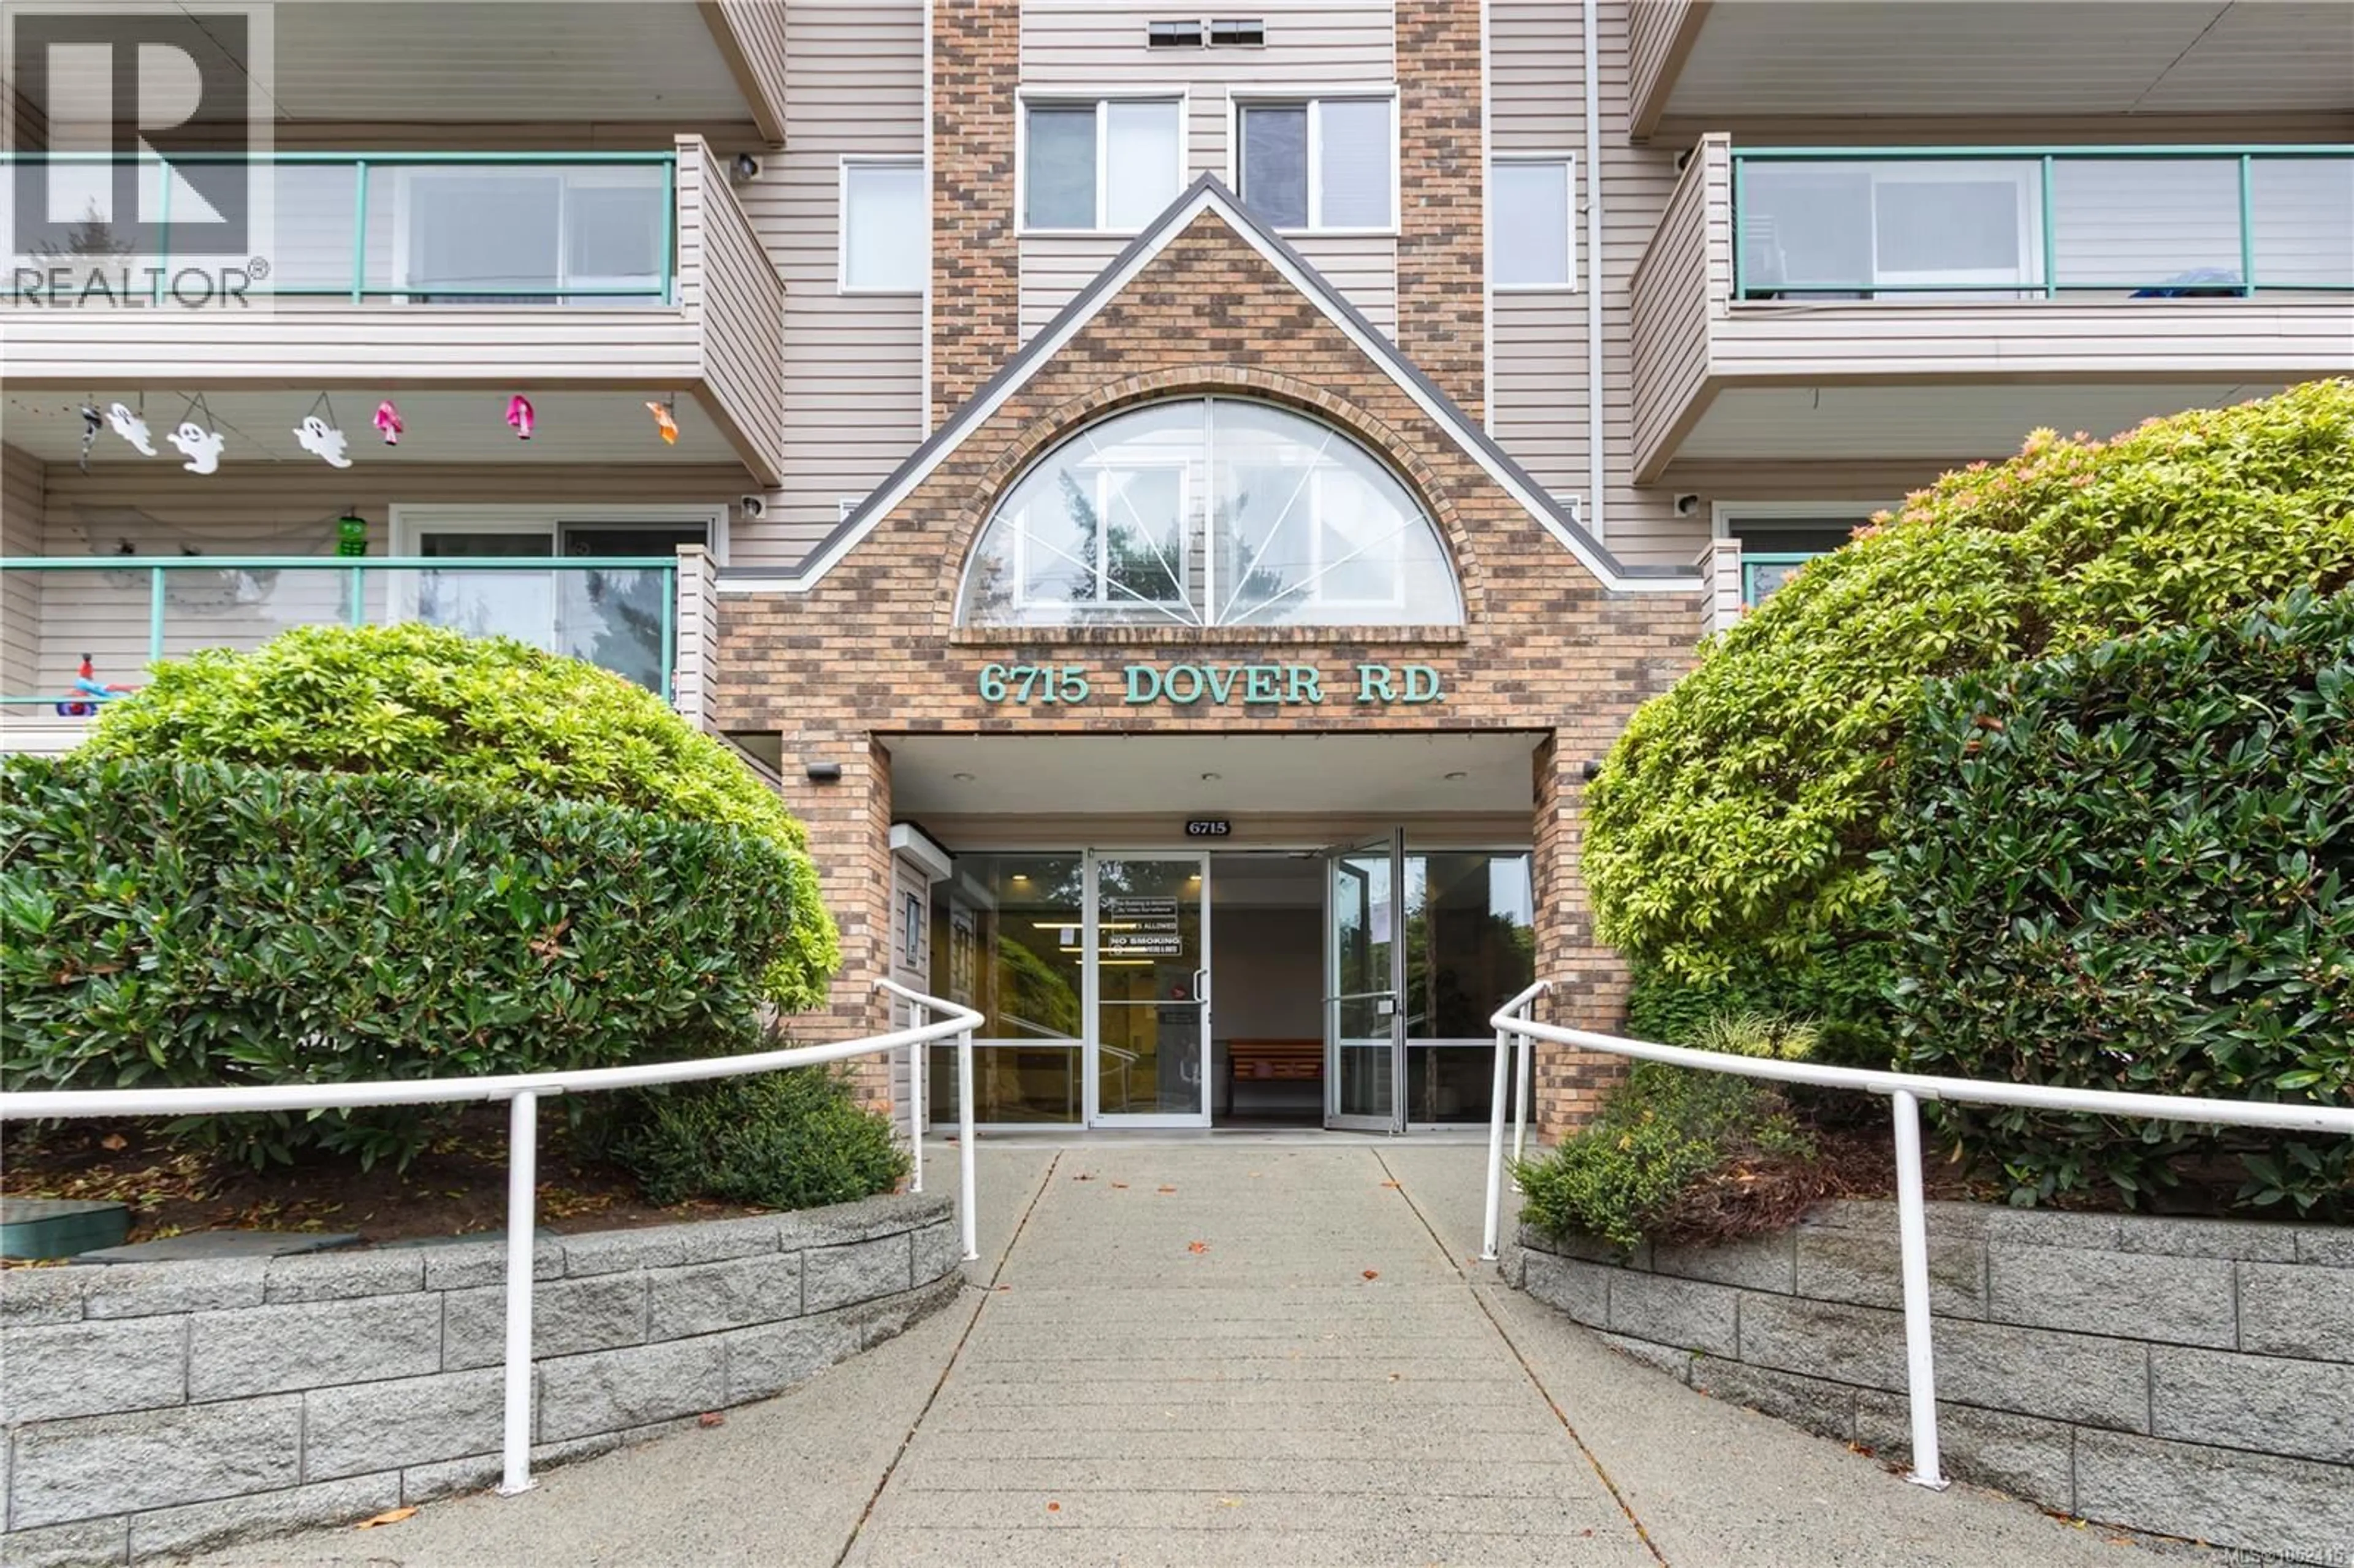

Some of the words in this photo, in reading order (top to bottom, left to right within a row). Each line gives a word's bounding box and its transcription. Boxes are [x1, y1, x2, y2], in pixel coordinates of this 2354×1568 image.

[980, 664, 1089, 703] 6715
[1123, 664, 1324, 703] DOVER
[1355, 664, 1447, 703] RD.
[1189, 822, 1227, 834] 6715
